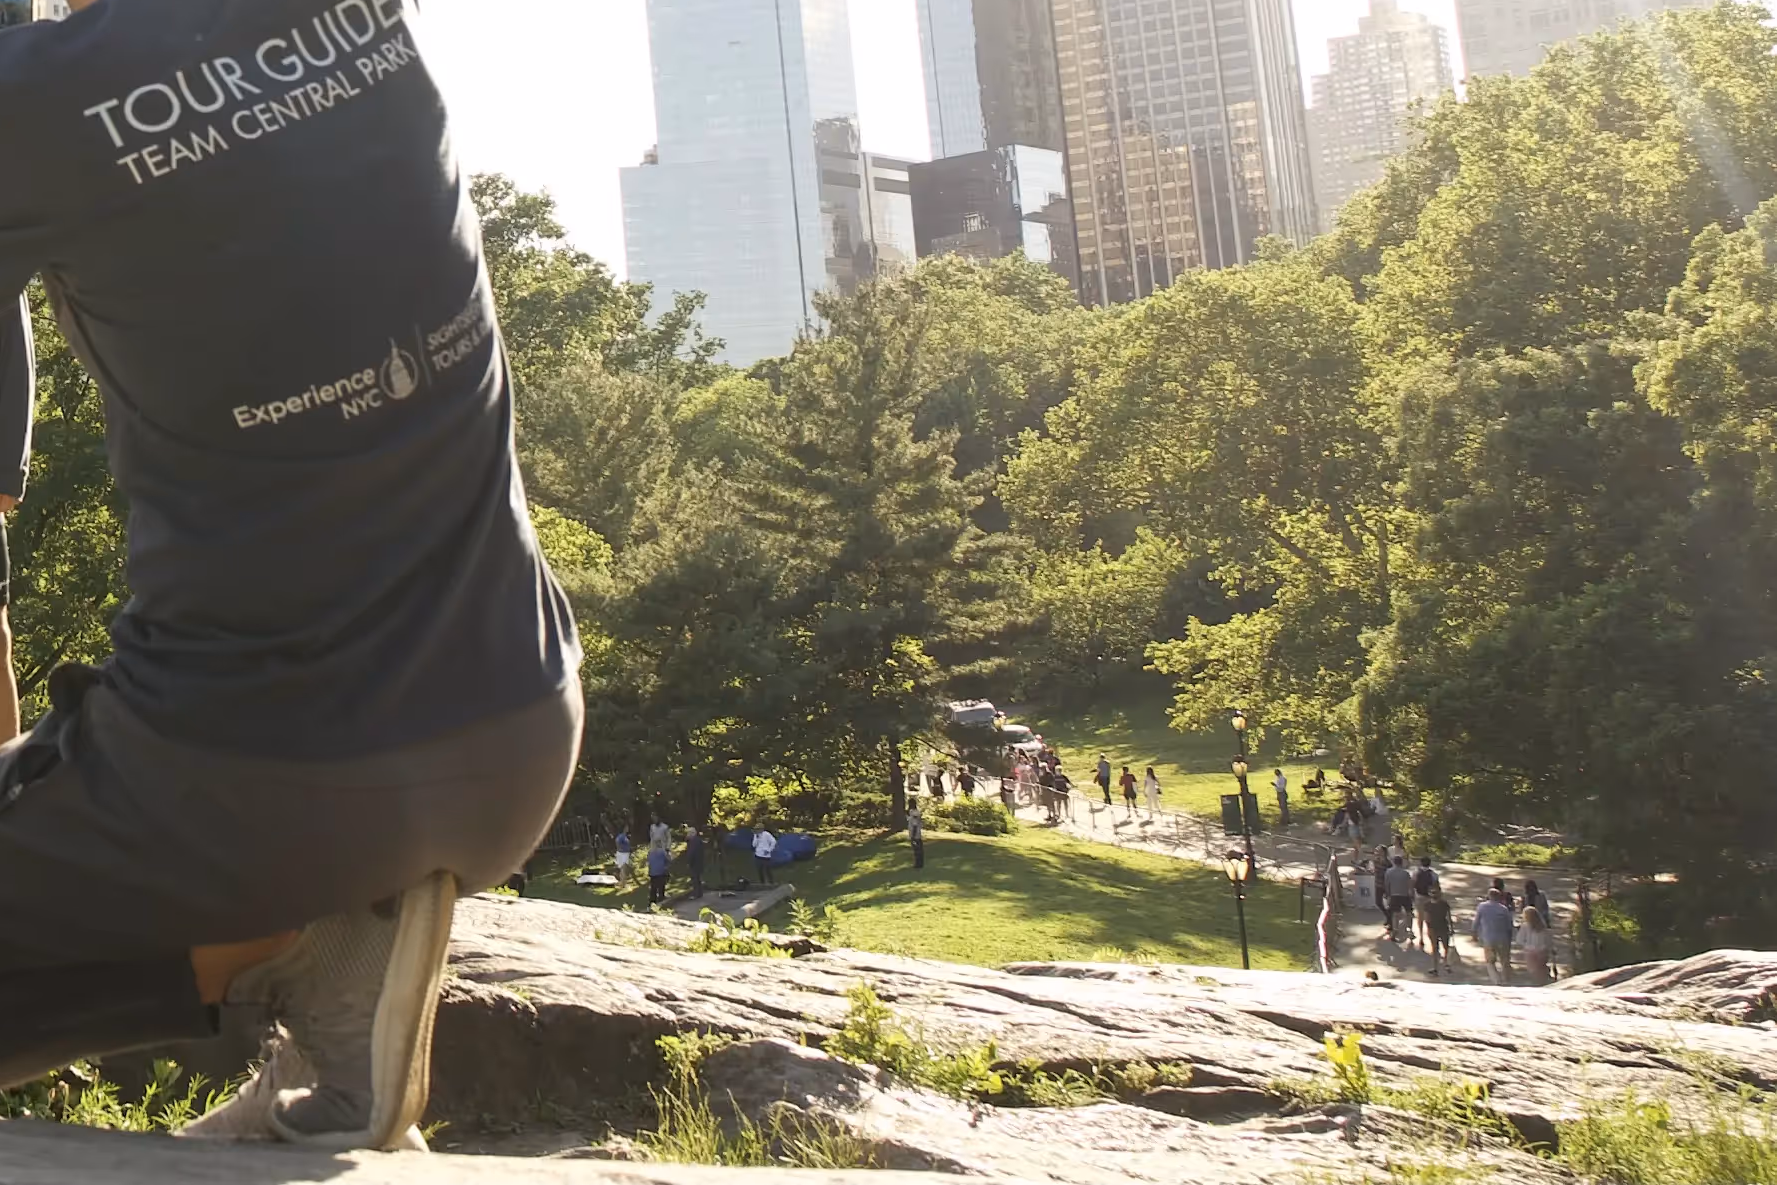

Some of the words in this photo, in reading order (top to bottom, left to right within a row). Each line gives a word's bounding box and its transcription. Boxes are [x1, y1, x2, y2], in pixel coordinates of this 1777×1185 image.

[83, 56, 262, 148] TOUR
[116, 125, 229, 185] TEAM
[231, 70, 362, 140] CENTRAL
[355, 33, 418, 86] PARK
[231, 367, 376, 429] Experience
[340, 388, 383, 420] NYC
